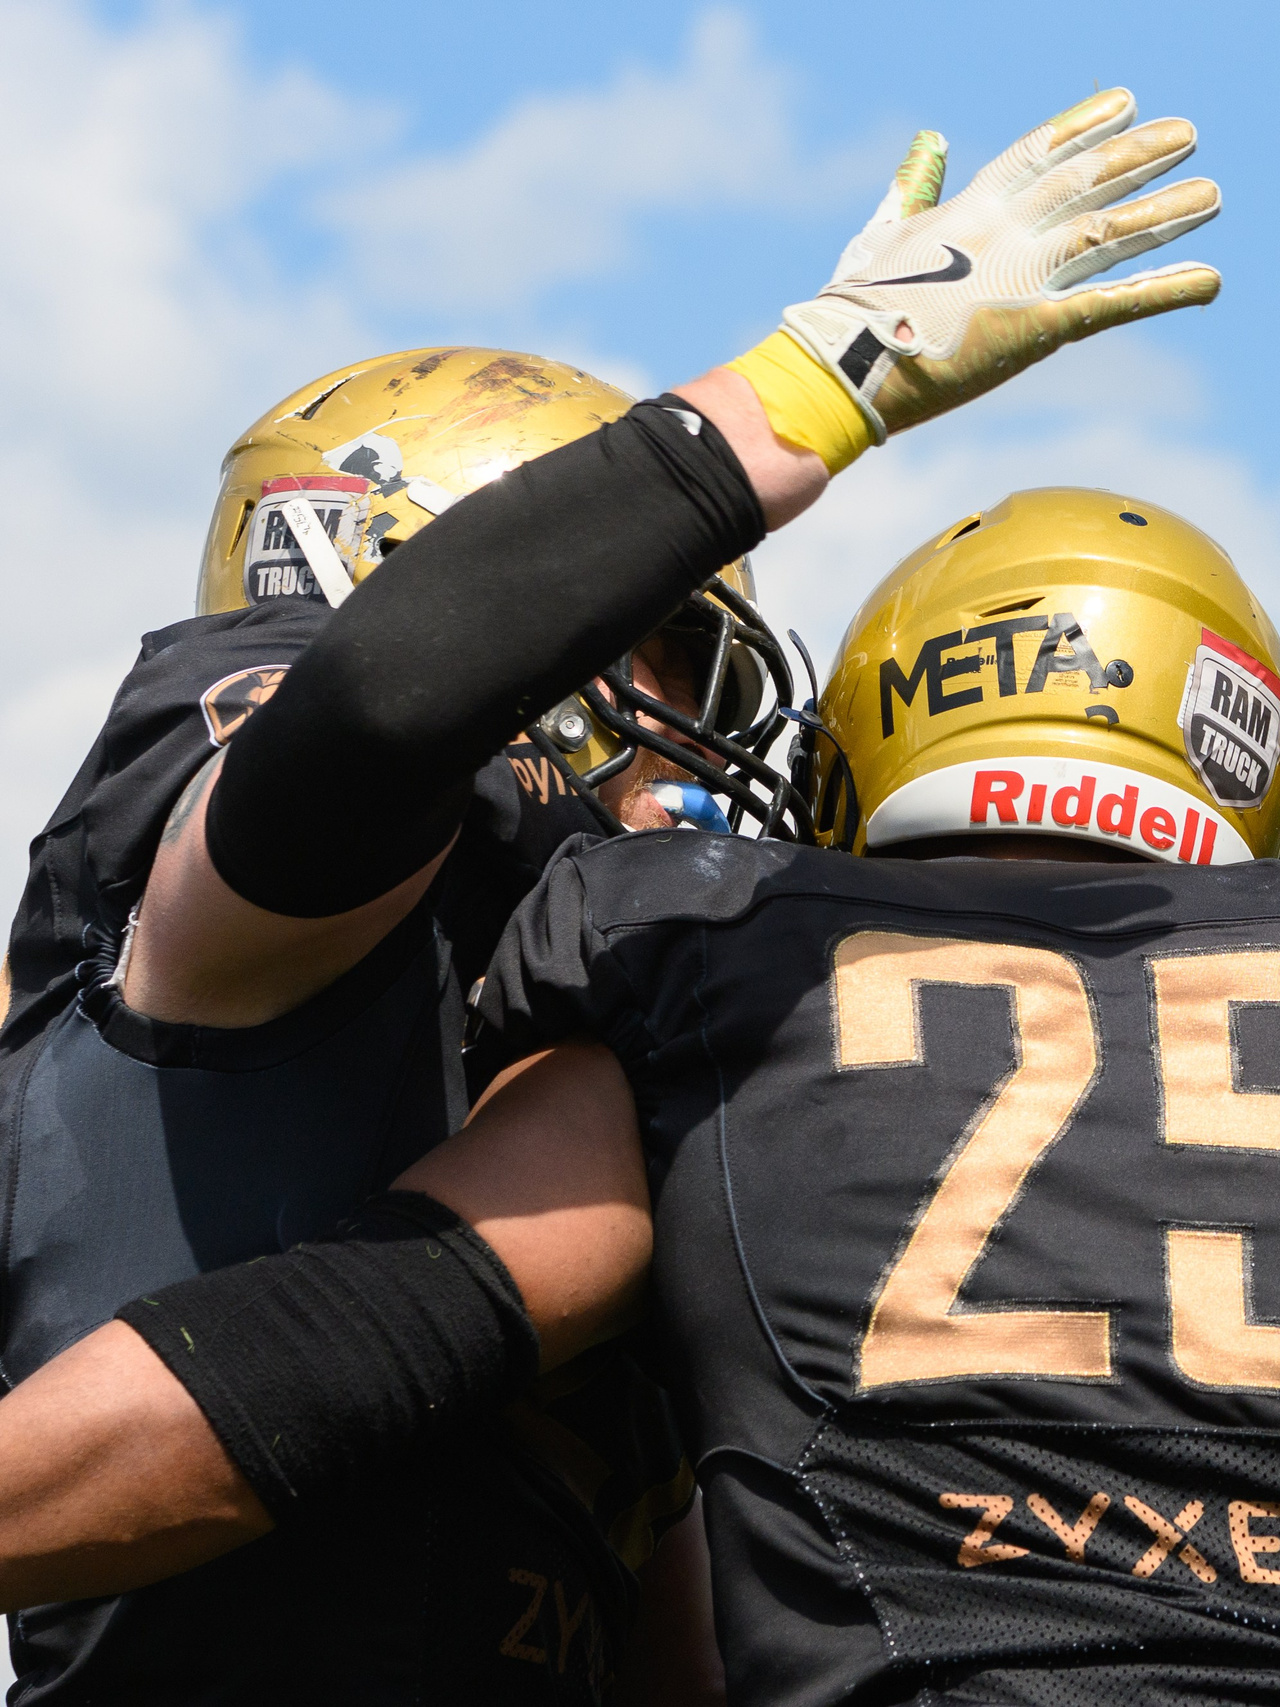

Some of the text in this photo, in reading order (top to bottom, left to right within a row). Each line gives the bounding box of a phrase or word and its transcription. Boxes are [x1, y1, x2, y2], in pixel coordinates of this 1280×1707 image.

[1210, 669, 1272, 750] RAM
[1200, 724, 1262, 794] TRUCK
[969, 769, 1219, 865] Riddell
